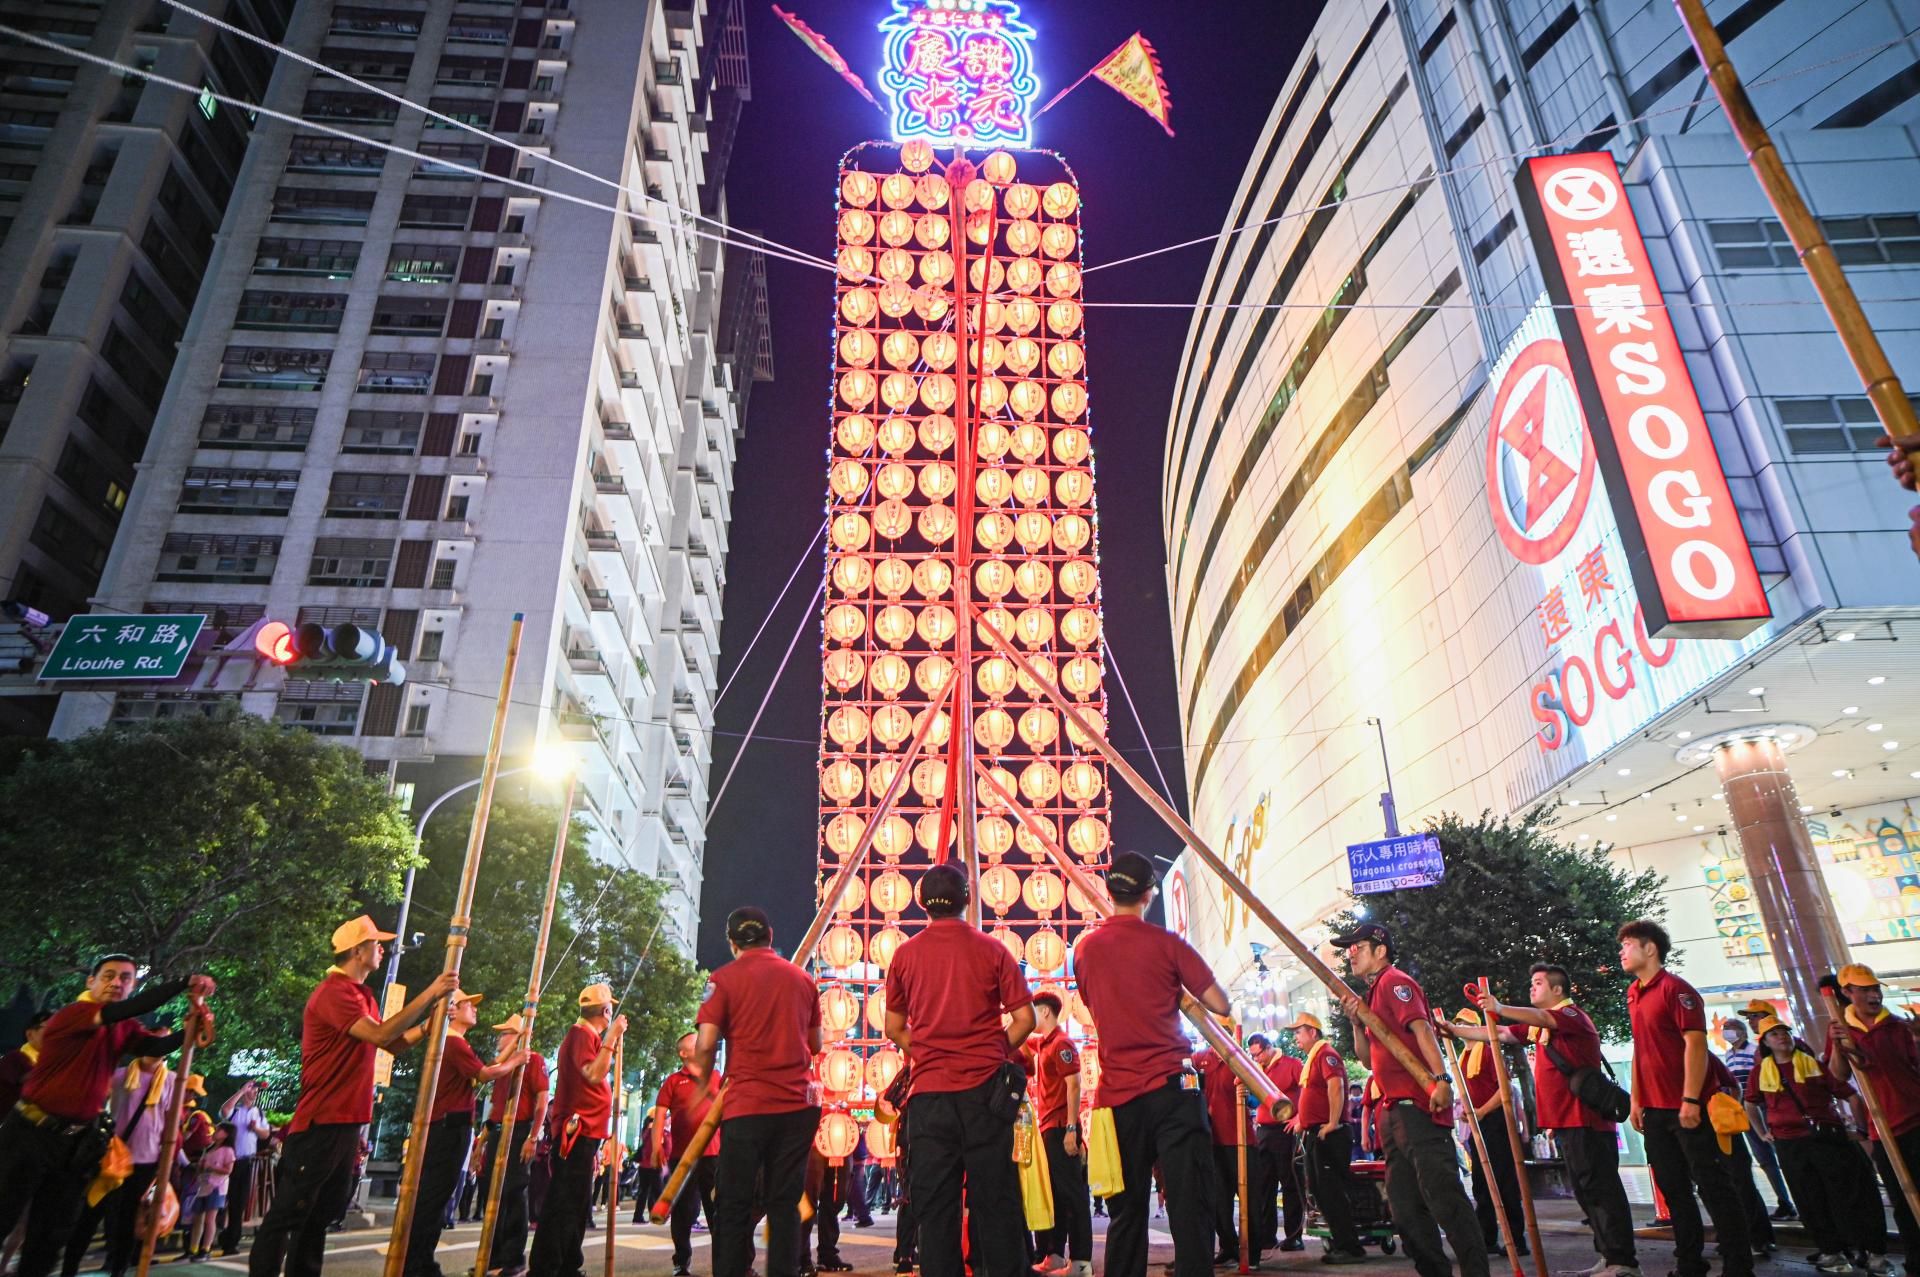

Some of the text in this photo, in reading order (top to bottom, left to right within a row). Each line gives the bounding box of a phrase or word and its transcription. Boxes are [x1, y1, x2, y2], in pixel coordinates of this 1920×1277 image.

[1535, 542, 1615, 651] 遠東
[75, 623, 183, 645] 六和路
[61, 654, 164, 672] Liouhe Rd.
[1353, 857, 1440, 879] Diagonal crossing
